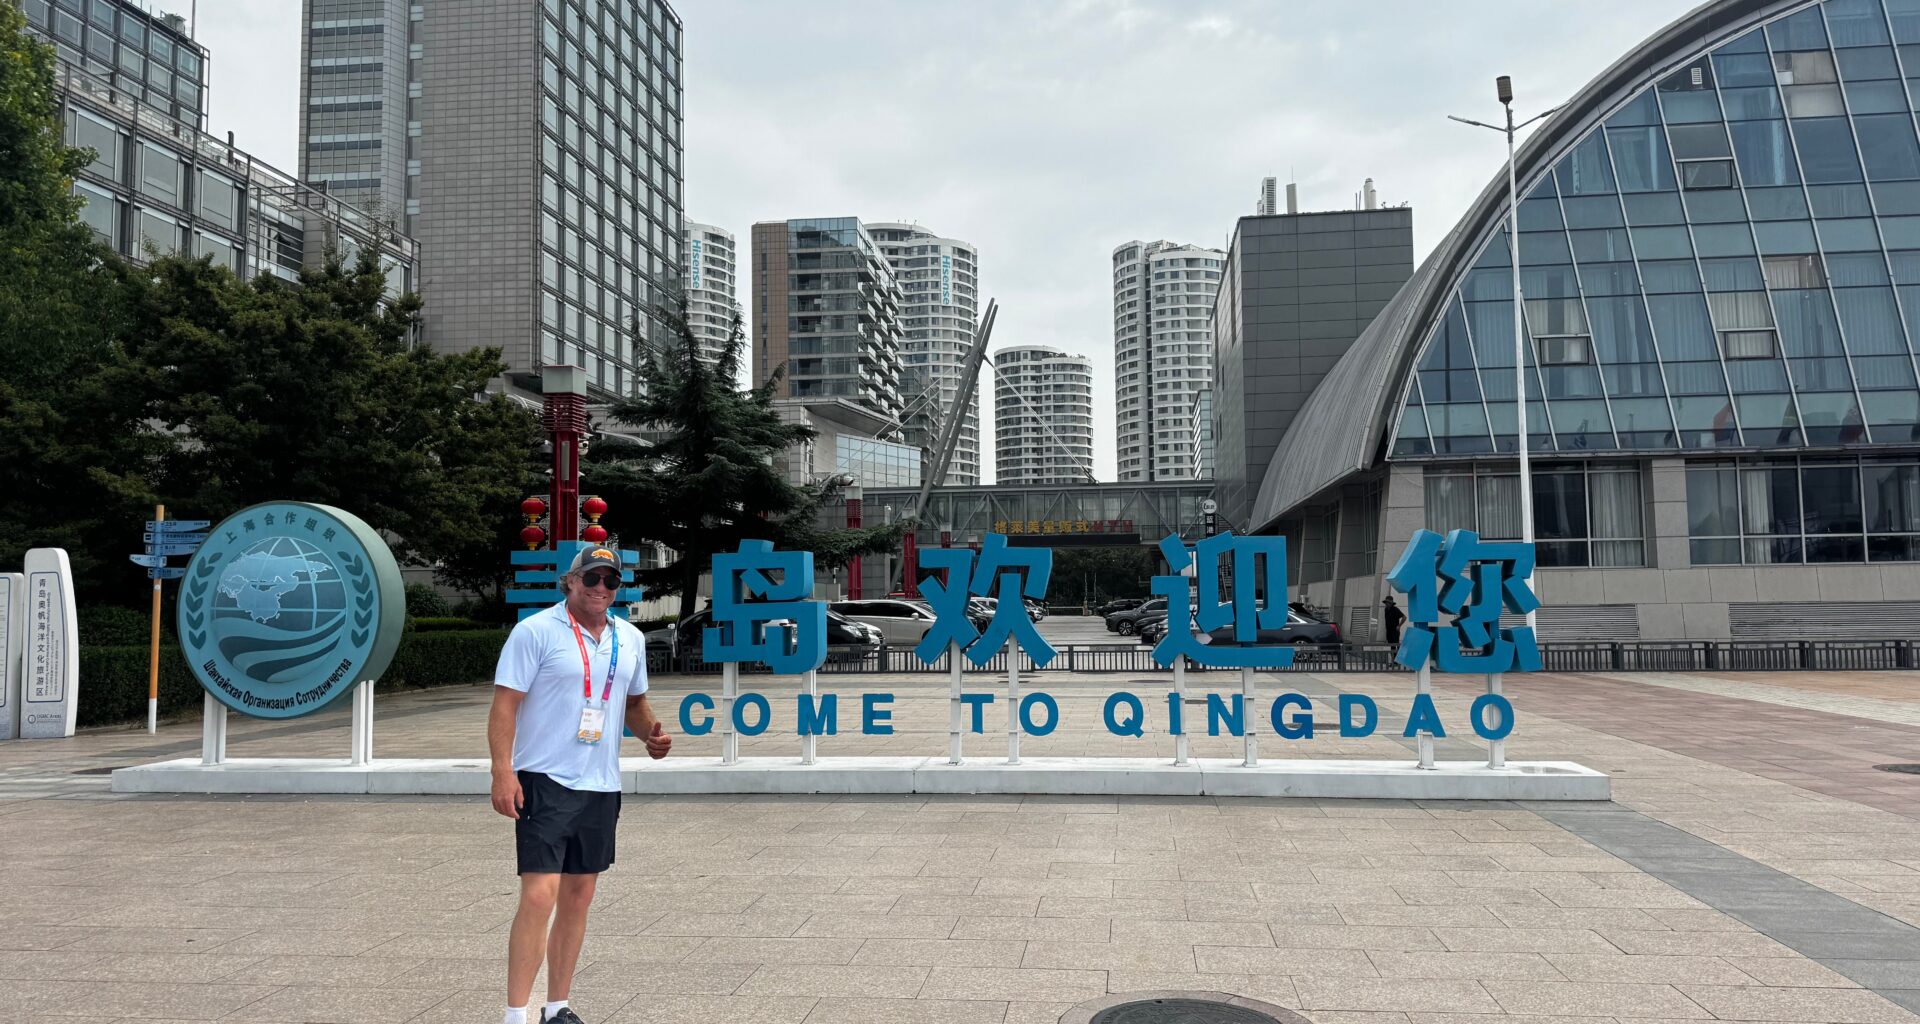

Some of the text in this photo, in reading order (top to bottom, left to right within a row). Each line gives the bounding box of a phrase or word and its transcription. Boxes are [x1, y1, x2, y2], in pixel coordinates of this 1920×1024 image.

[692, 239, 701, 289] Hisense
[942, 255, 951, 305] Hisense
[225, 511, 337, 545] 上海合作组织
[203, 657, 352, 711] Шанхайская Организация Сотрудничества
[622, 692, 1516, 741] COME TO QINGDAO
